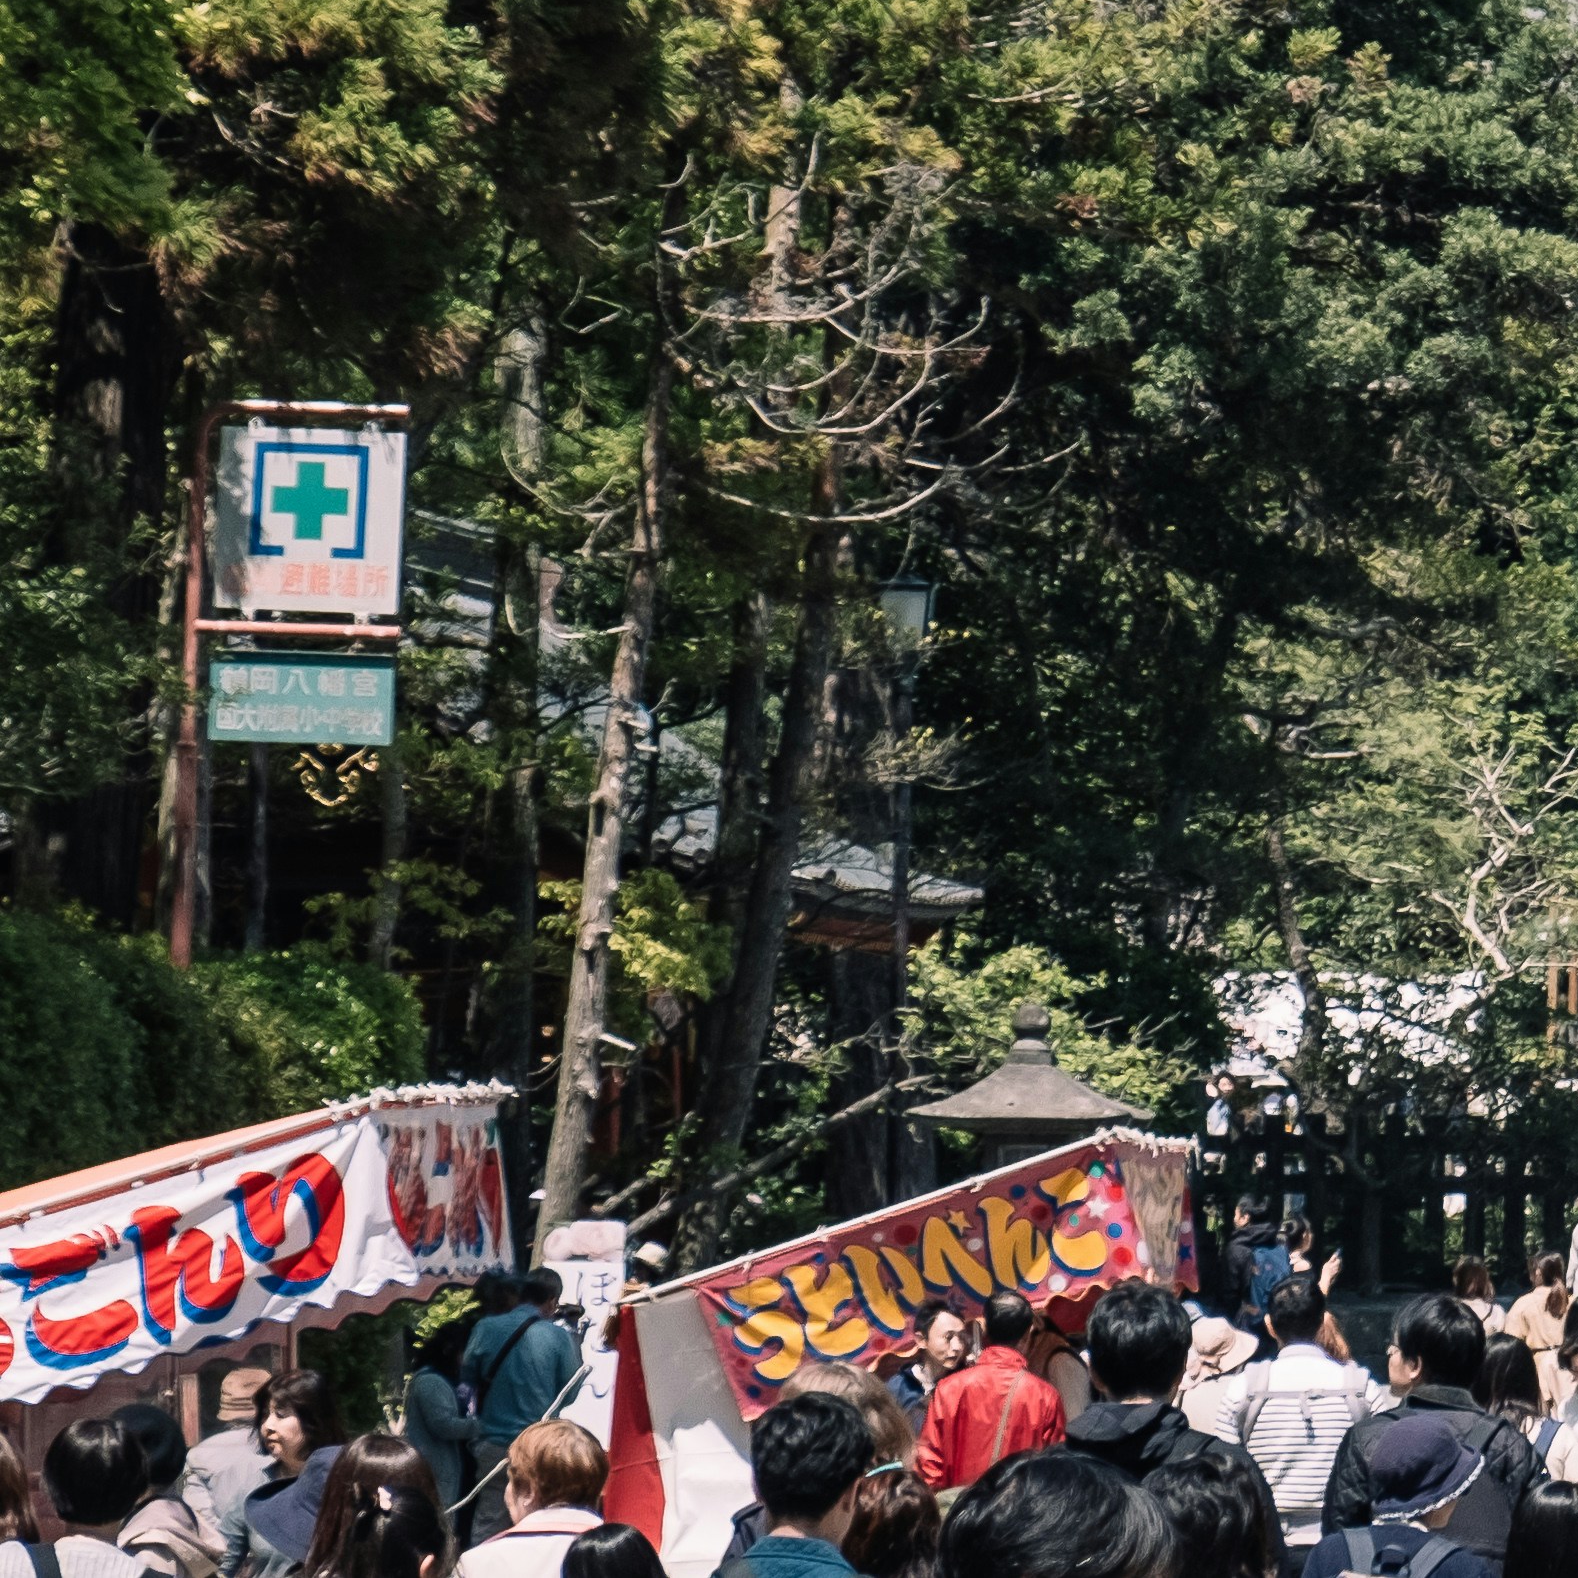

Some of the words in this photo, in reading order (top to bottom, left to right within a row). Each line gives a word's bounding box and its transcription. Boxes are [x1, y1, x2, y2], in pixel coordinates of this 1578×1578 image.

[222, 563, 389, 598] 避難場所
[219, 666, 379, 698] 鶴岡八幡宮
